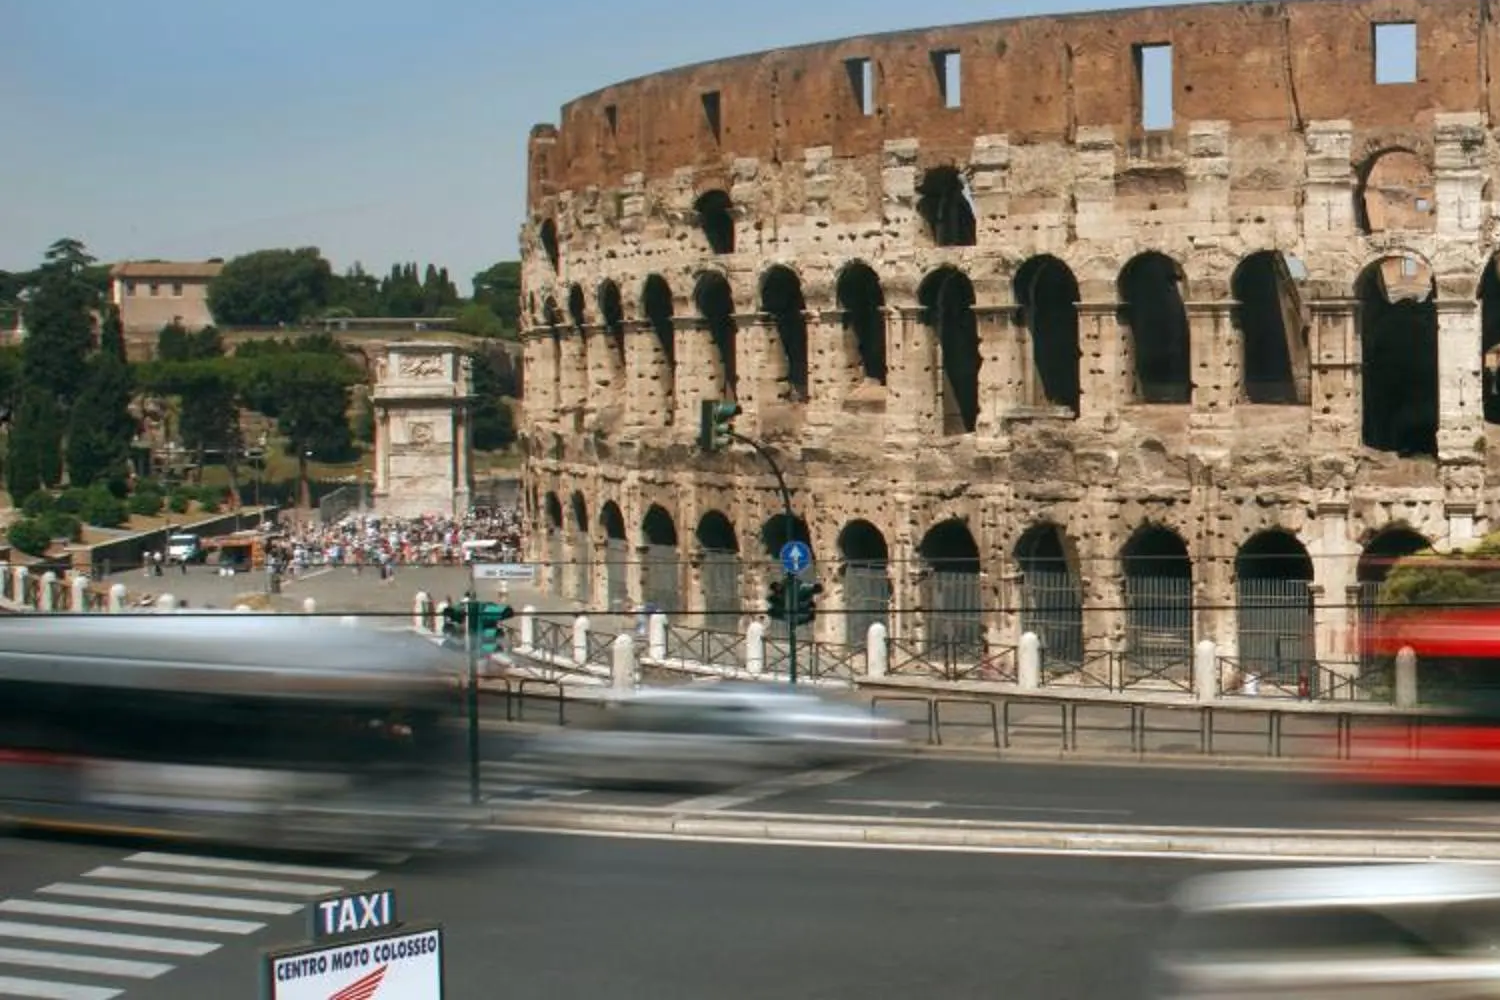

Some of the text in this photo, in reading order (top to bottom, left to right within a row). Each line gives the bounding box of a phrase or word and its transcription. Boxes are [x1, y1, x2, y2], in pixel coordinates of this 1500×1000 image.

[320, 892, 391, 934] TAXI
[277, 936, 437, 980] CENTRO MOTO COLOSSEO
